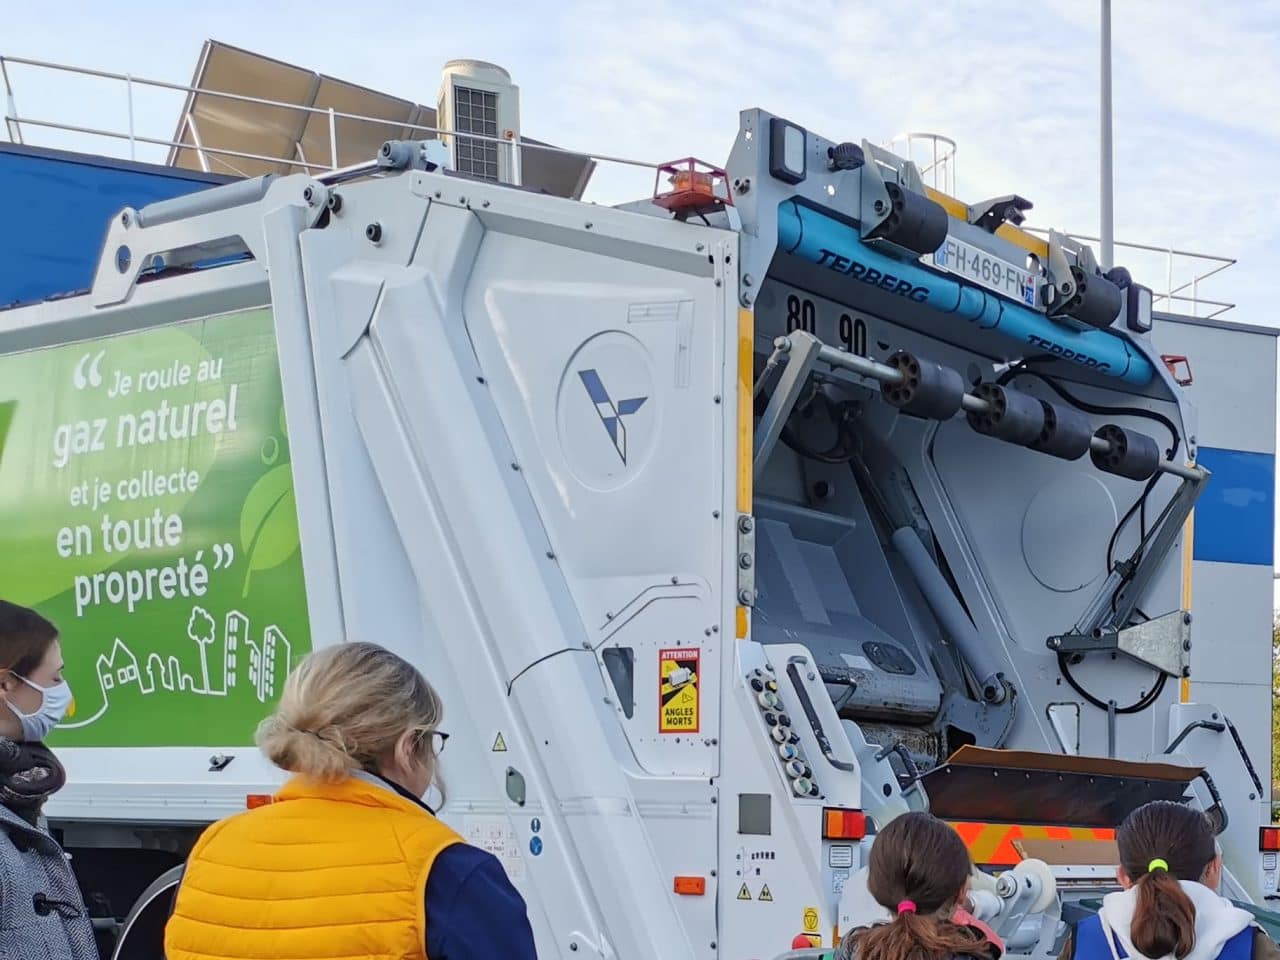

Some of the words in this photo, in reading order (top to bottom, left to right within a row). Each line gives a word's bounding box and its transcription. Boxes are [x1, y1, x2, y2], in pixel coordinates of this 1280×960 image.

[816, 249, 930, 302] TERBERG
[840, 313, 867, 357] 90
[138, 359, 191, 393] roule
[197, 357, 223, 382] au
[53, 418, 107, 468] gaz
[116, 383, 238, 448] naturel
[70, 480, 88, 506] et
[92, 477, 111, 511] je
[117, 467, 199, 500] collecte
[56, 524, 92, 557] en
[101, 508, 183, 553] toute
[662, 651, 698, 659] ATTENTION
[665, 707, 694, 716] ANGLES
[666, 716, 693, 726] MORTS
